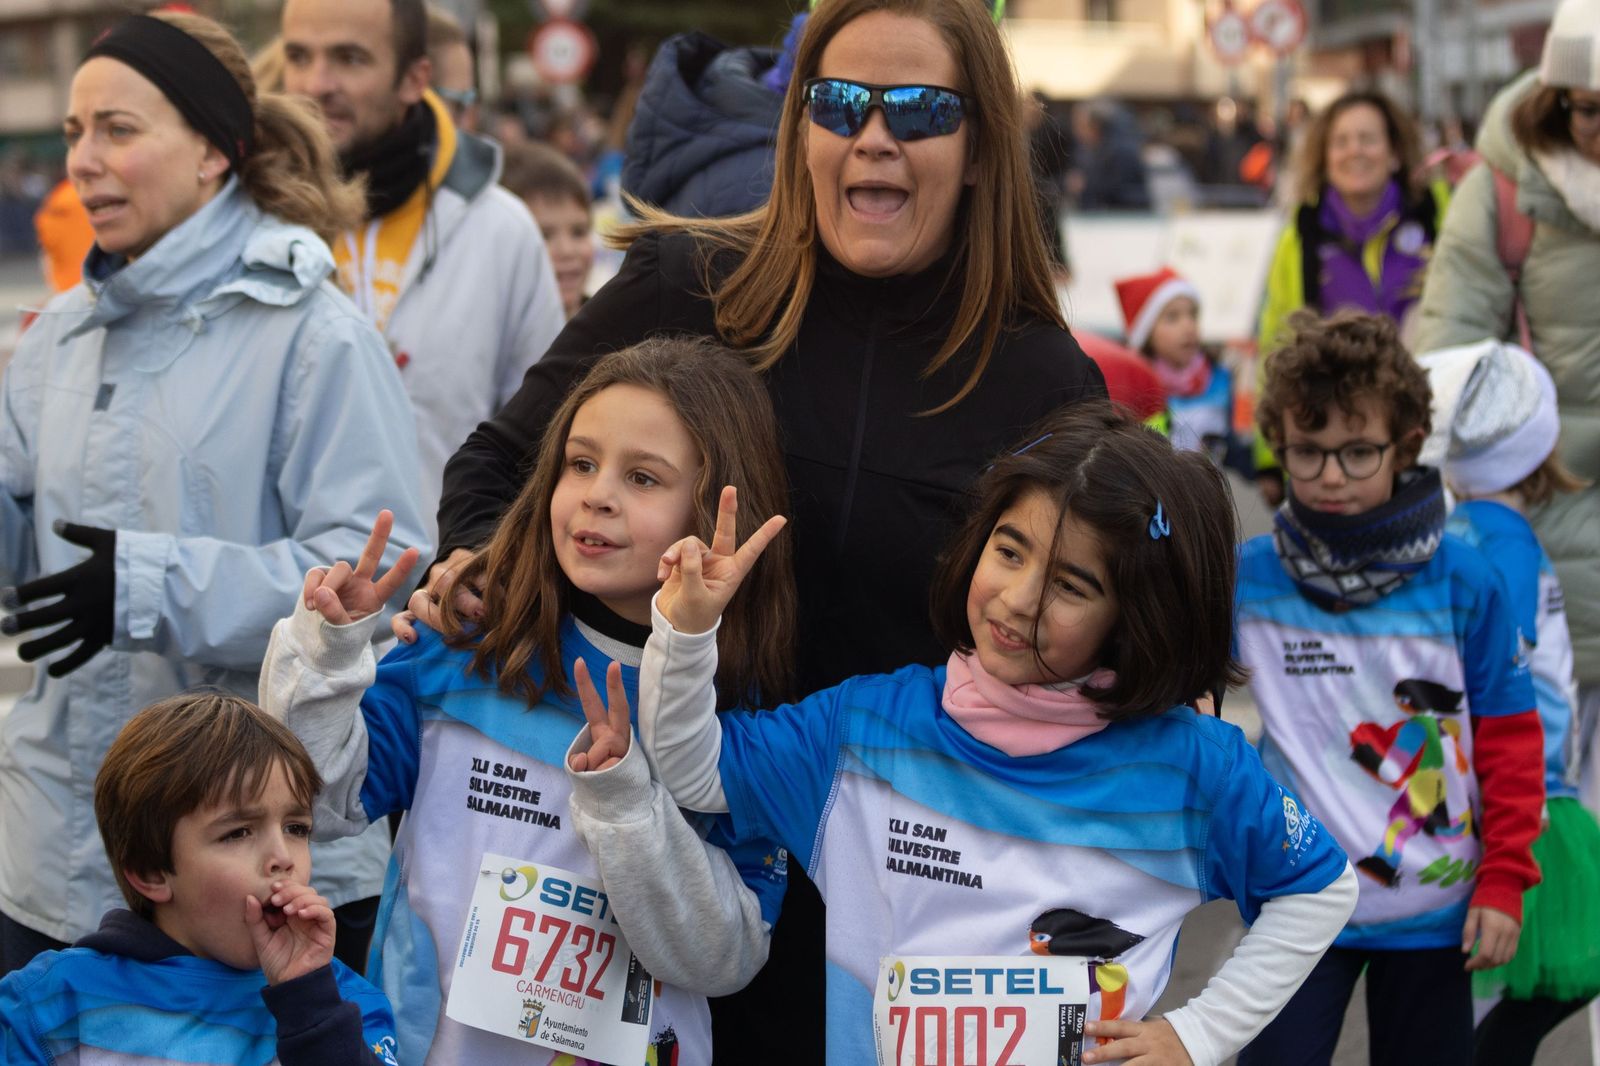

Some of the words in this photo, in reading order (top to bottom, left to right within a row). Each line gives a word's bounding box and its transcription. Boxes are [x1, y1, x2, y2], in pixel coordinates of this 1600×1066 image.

[471, 757, 490, 774] XLI
[493, 763, 527, 782] SAN
[469, 776, 541, 805] SILVESTRE
[467, 795, 561, 830] SALMANTINA
[912, 823, 947, 842] SAN
[888, 837, 961, 865] ILVESTRE
[540, 877, 618, 925] SET
[491, 906, 616, 1000] 6732
[516, 979, 586, 1010] CARMENCHU
[910, 968, 1064, 995] SETEL
[540, 1030, 550, 1041] de
[551, 1032, 585, 1051] Salamanca
[543, 1016, 588, 1038] Ayuntamiento
[889, 1007, 1026, 1066] 7002
